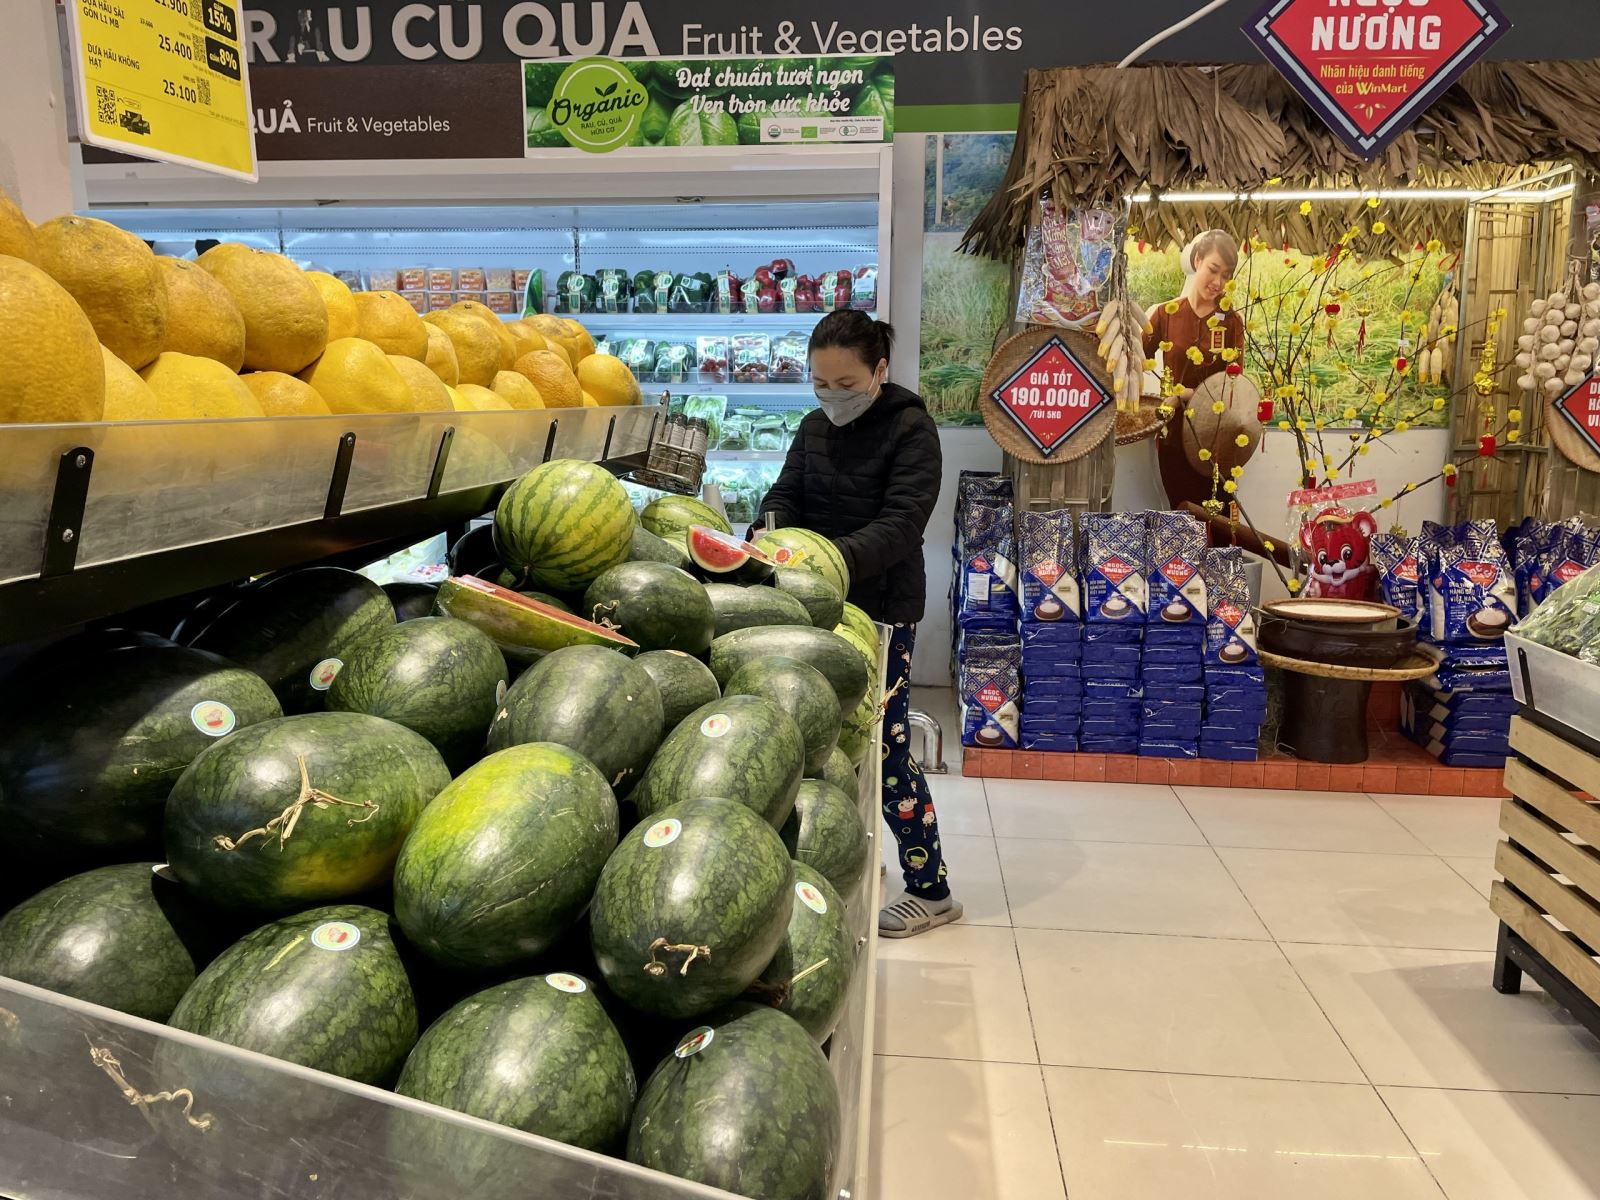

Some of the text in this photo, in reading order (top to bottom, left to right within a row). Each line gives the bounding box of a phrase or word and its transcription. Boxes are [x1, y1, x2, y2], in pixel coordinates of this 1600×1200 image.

[208, 8, 232, 33] 15%
[682, 23, 763, 55] Fruit
[774, 20, 802, 54] &
[811, 15, 1023, 54] Vegetables
[158, 34, 192, 61] 25.400
[219, 48, 238, 71] 8%
[675, 63, 864, 92] Đạt chuẩn tươi ngon
[1320, 63, 1425, 80] Nhãn hiệu danh tiếng
[162, 79, 197, 104] 25.100
[1336, 81, 1408, 95] của WinMart
[551, 88, 645, 126] Organic
[728, 93, 767, 114] tròn
[770, 93, 802, 114] sức
[805, 90, 851, 113] khỏe
[307, 117, 343, 133] Fruit
[346, 117, 359, 133] &
[361, 115, 450, 137] Vegetables
[1030, 368, 1073, 386] GIÁ TỐT
[1010, 386, 1092, 408] 190.000đ
